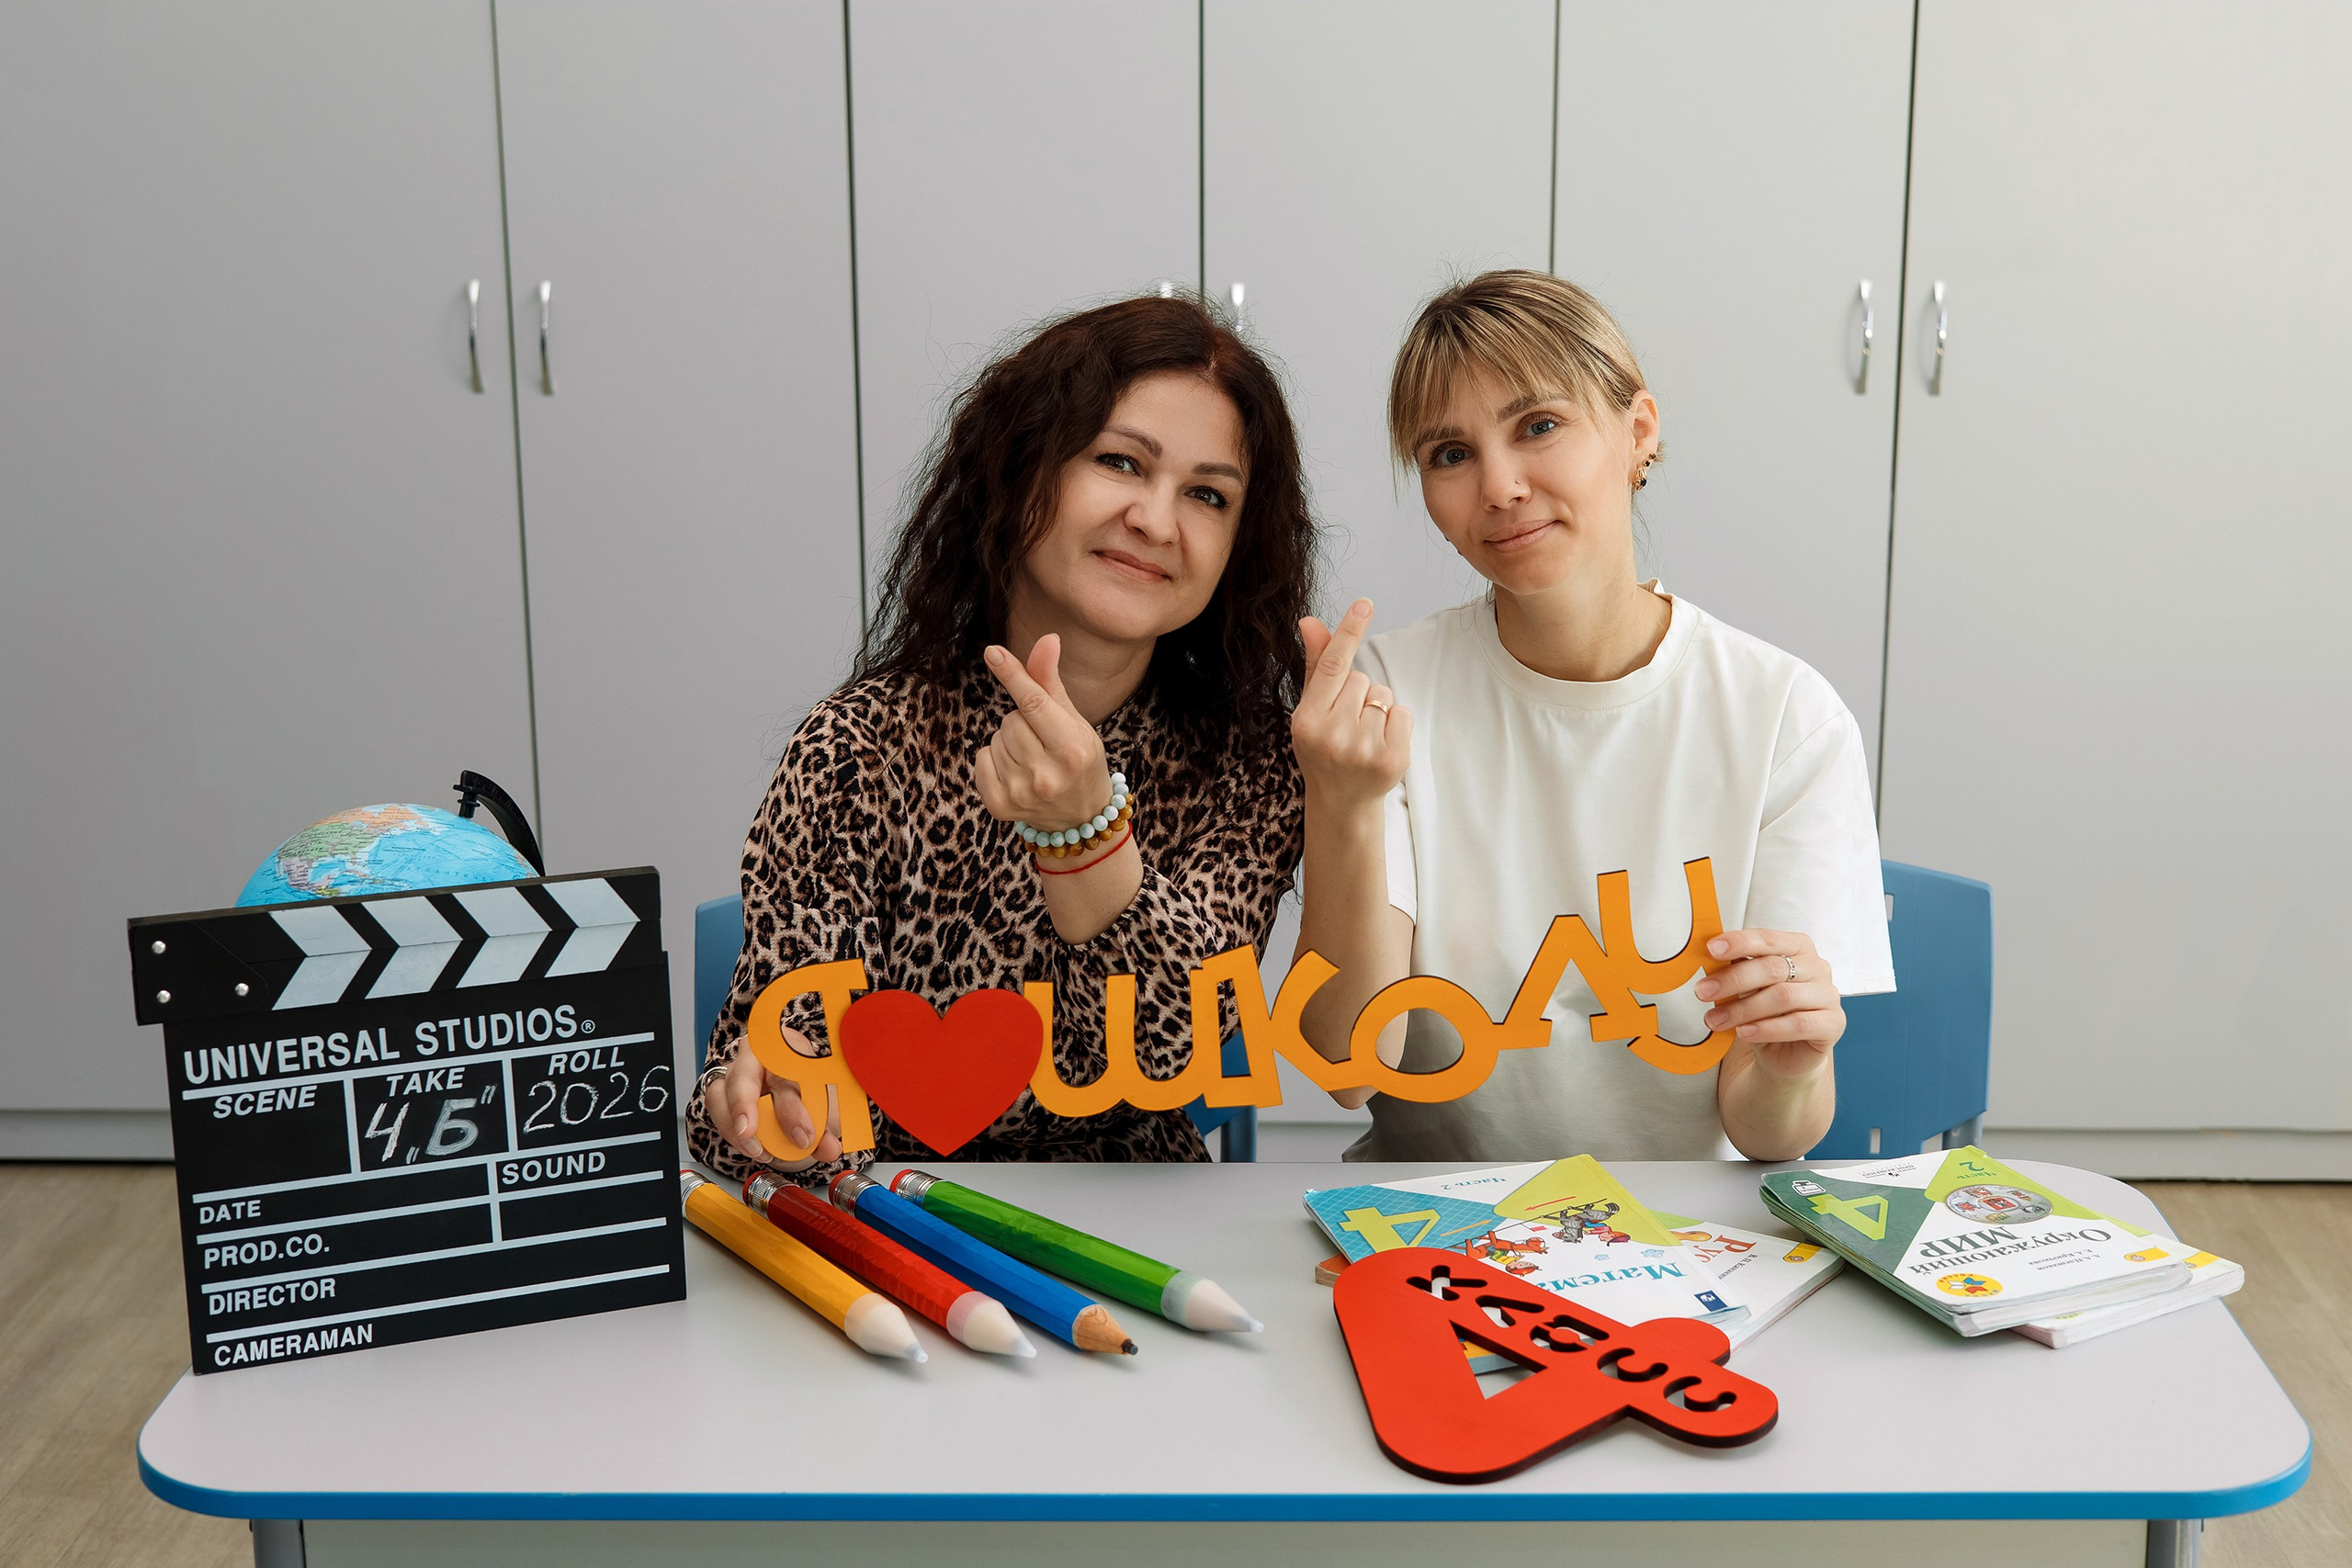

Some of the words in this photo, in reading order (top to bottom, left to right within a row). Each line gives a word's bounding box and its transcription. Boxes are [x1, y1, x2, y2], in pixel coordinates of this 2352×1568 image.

[183, 1026, 401, 1085] UNIVERSAL
[548, 1046, 626, 1077] ROLL
[746, 958, 876, 1162] Я
[386, 1066, 466, 1098] TAKE
[523, 1065, 671, 1134] 2026
[212, 1085, 319, 1119] SCENE
[501, 1151, 606, 1185] SOUND
[1958, 1160, 1985, 1173] 2
[198, 1200, 261, 1225] DATE
[1339, 1206, 1442, 1254] 4
[1806, 1193, 1890, 1241] 4
[204, 1233, 331, 1270] PROD.CO.
[1908, 1228, 2112, 1276] Окружающий
[209, 1278, 336, 1316] DIRECTOR
[214, 1323, 374, 1368] CAMERAMAN
